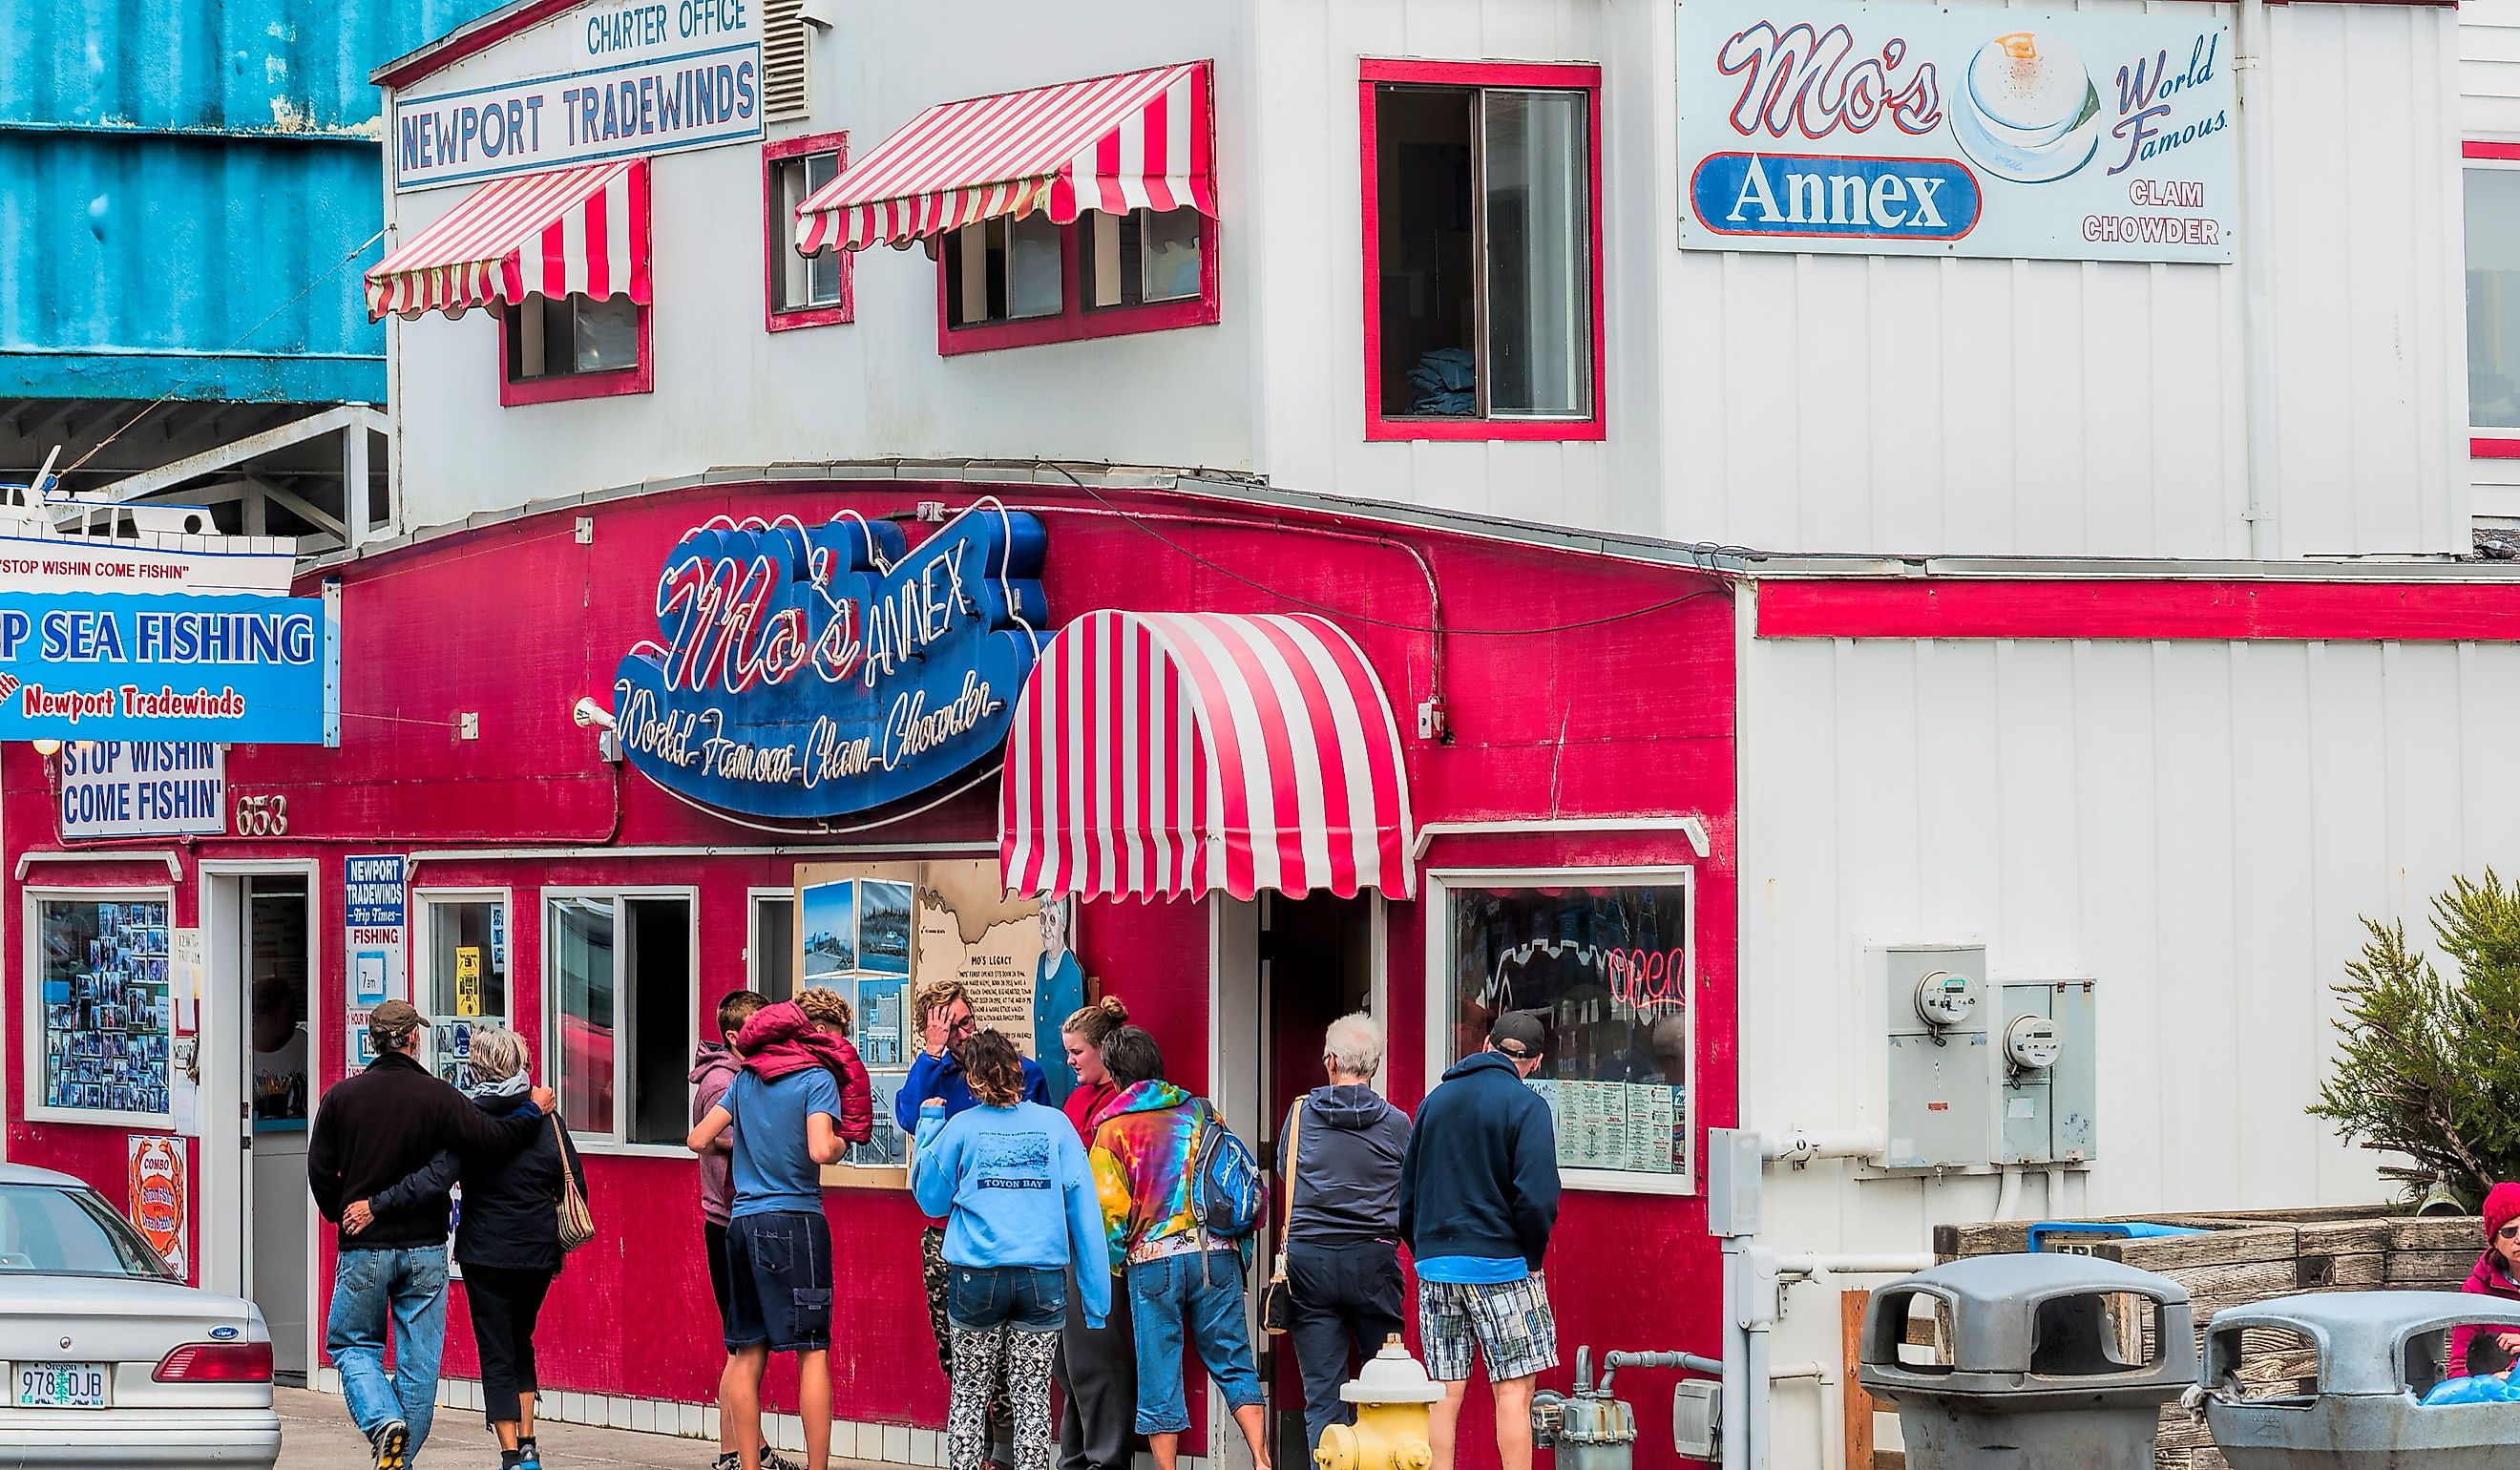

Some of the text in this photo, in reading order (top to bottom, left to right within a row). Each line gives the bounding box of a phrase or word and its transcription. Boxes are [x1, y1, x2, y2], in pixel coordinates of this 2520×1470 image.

[587, 0, 747, 55] CHARTER OFFICE
[1717, 19, 1942, 139] Mo's
[2115, 32, 2217, 116] World
[401, 60, 755, 171] NEWPORT TRADEWINDS
[1725, 152, 1948, 229] Annex
[2129, 178, 2203, 208] CLAM
[2081, 214, 2220, 246] CHOWDER
[42, 560, 92, 577] WISHIN
[94, 562, 136, 578] COME
[657, 537, 970, 695] Mo's ANNEX
[42, 612, 127, 662] SEA
[136, 613, 315, 664] FISHING
[25, 684, 115, 722] Newport
[121, 685, 244, 716] Tradewinds
[615, 670, 1000, 788] World Famous Clam Chowder
[63, 741, 122, 776] STOP
[63, 779, 222, 825] COME FISHIN'
[236, 795, 287, 836] 653
[350, 859, 399, 881] NEWPORT
[346, 884, 403, 905] TRADEWINDS
[353, 928, 399, 944] FISHING
[989, 956, 1012, 965] LEGACY
[361, 972, 376, 988] 7am
[350, 1013, 365, 1025] HOUR
[144, 1158, 169, 1171] COMBO
[984, 1179, 1044, 1188] TOYON BAY
[45, 1362, 77, 1372] Oregon
[23, 1371, 101, 1396] 978 DJB
